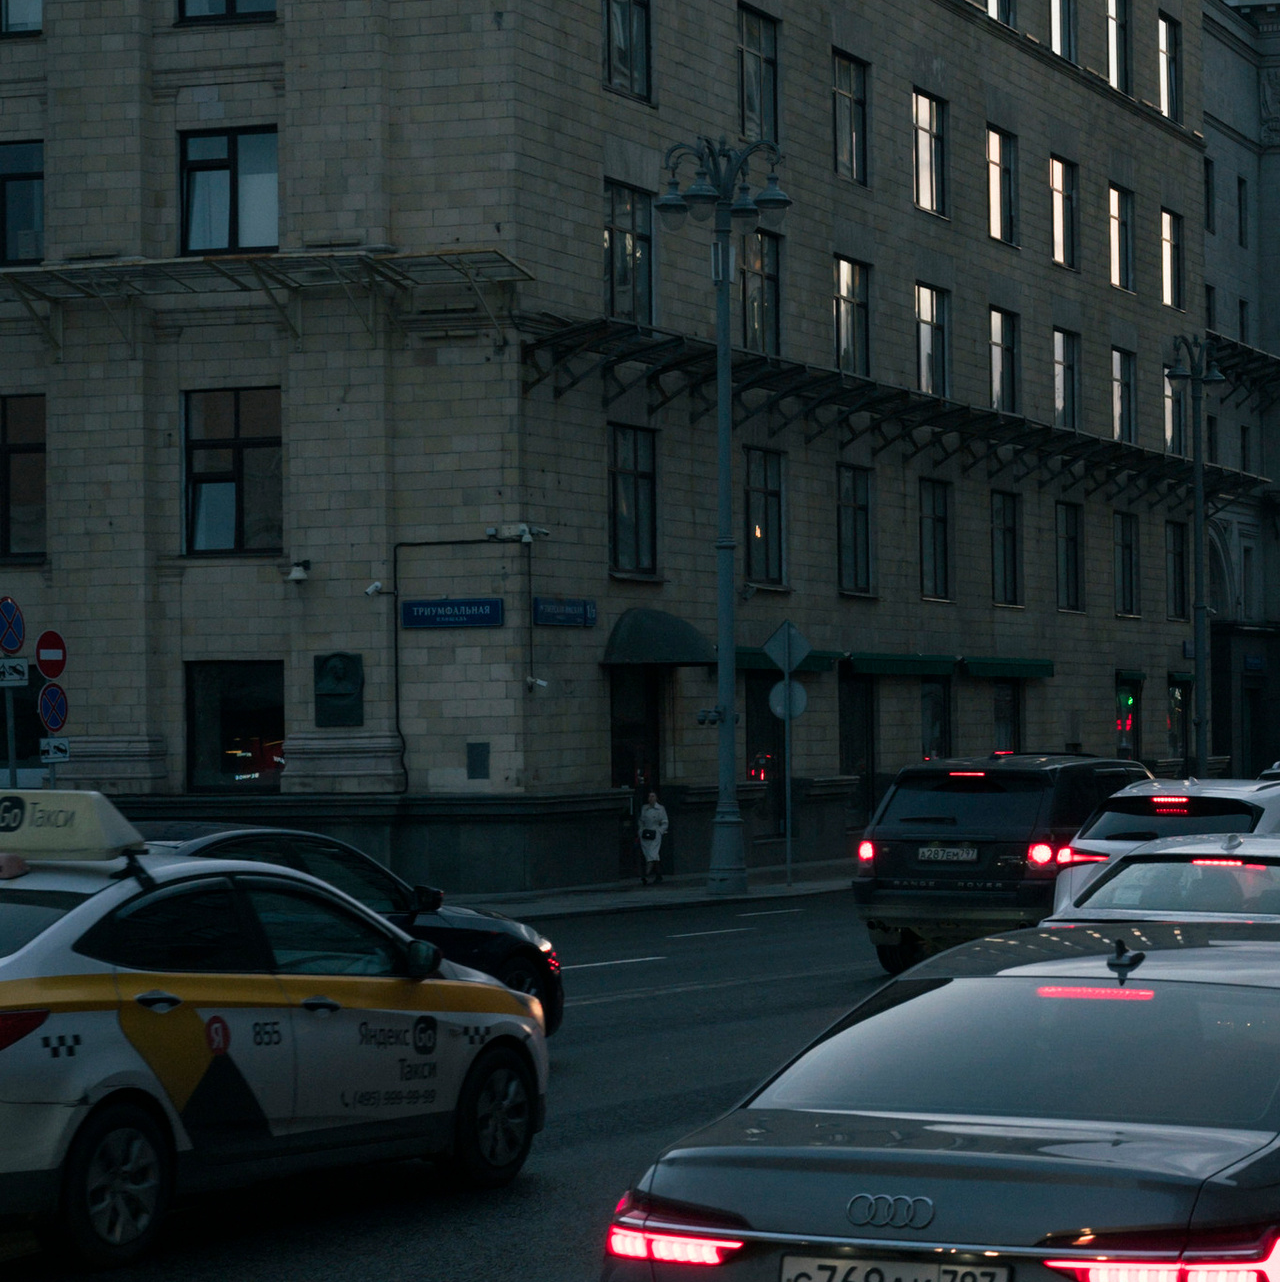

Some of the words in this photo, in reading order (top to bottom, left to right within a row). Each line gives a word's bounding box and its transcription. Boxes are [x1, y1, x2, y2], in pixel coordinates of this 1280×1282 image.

[412, 605, 490, 616] ТРИУМФАЛЬНАЯ
[29, 801, 76, 828] Такси
[211, 1023, 224, 1049] Я
[253, 1021, 282, 1046] 855
[359, 1021, 410, 1048] Яндекс
[415, 1022, 436, 1048] Go
[399, 1058, 437, 1081] Такси
